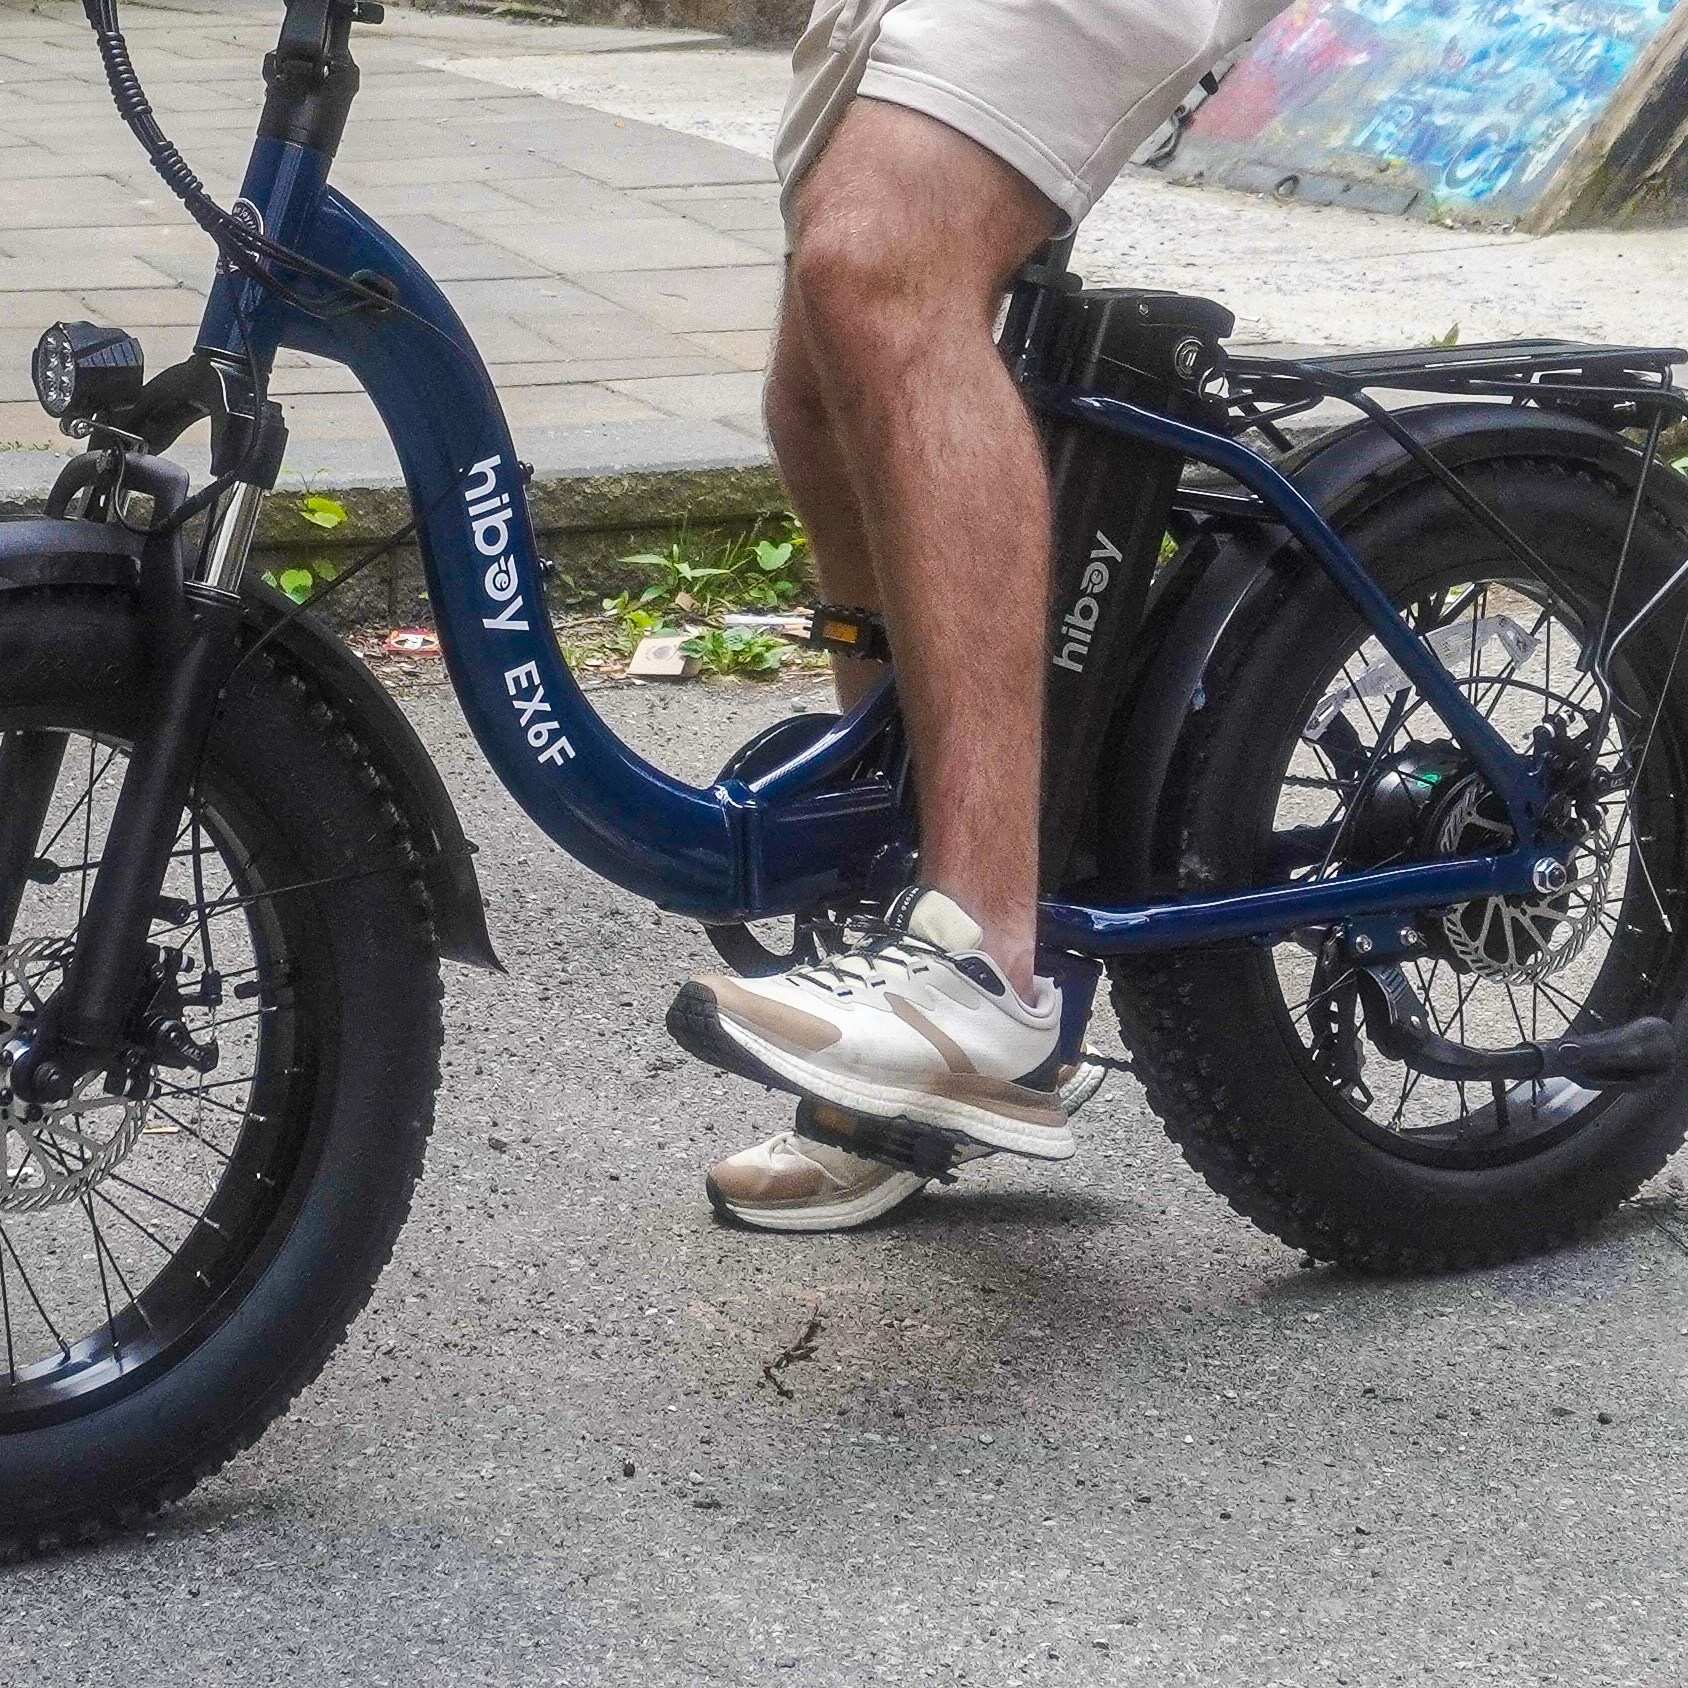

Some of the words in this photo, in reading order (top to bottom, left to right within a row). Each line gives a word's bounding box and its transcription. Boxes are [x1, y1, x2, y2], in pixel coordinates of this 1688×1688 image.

[463, 455, 529, 632] hiboy
[504, 660, 576, 767] EX6F
[1052, 529, 1123, 673] hiboy
